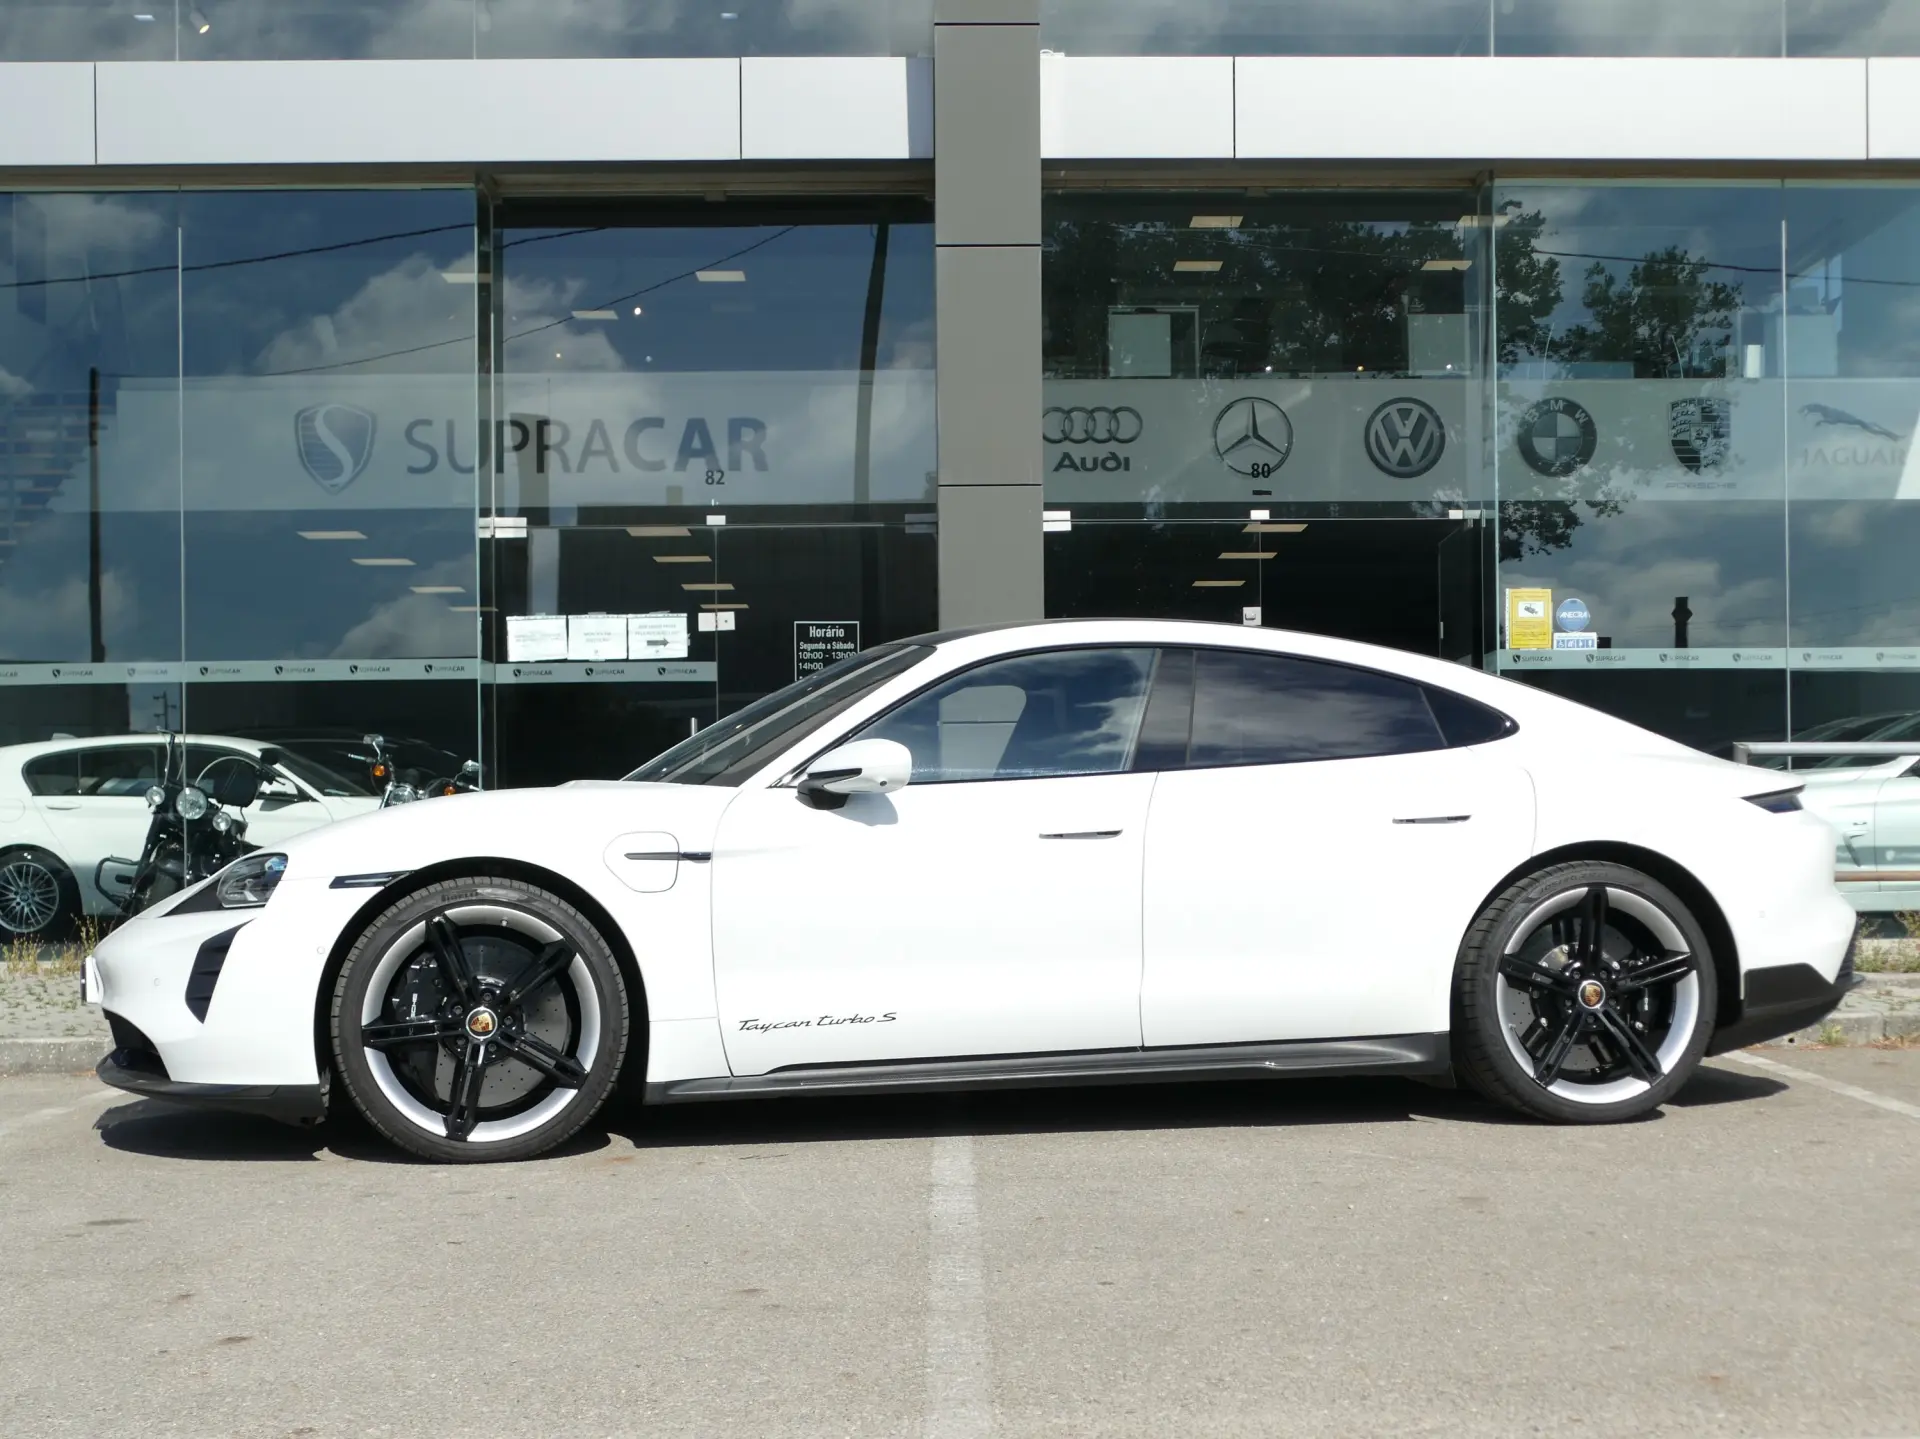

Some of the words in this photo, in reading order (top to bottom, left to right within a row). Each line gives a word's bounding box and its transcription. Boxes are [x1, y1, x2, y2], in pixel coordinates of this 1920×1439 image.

[405, 417, 769, 474] SUPRACAR
[1052, 452, 1130, 472] Audi
[1802, 447, 1907, 468] JAGUAR
[705, 470, 725, 486] 82
[1250, 463, 1271, 479] 80
[809, 625, 845, 637] Horário
[799, 641, 825, 651] Segunda
[832, 641, 855, 649] Sábado
[798, 651, 823, 659] 10h00
[739, 1019, 812, 1034] Taycan
[877, 1012, 897, 1023] S
